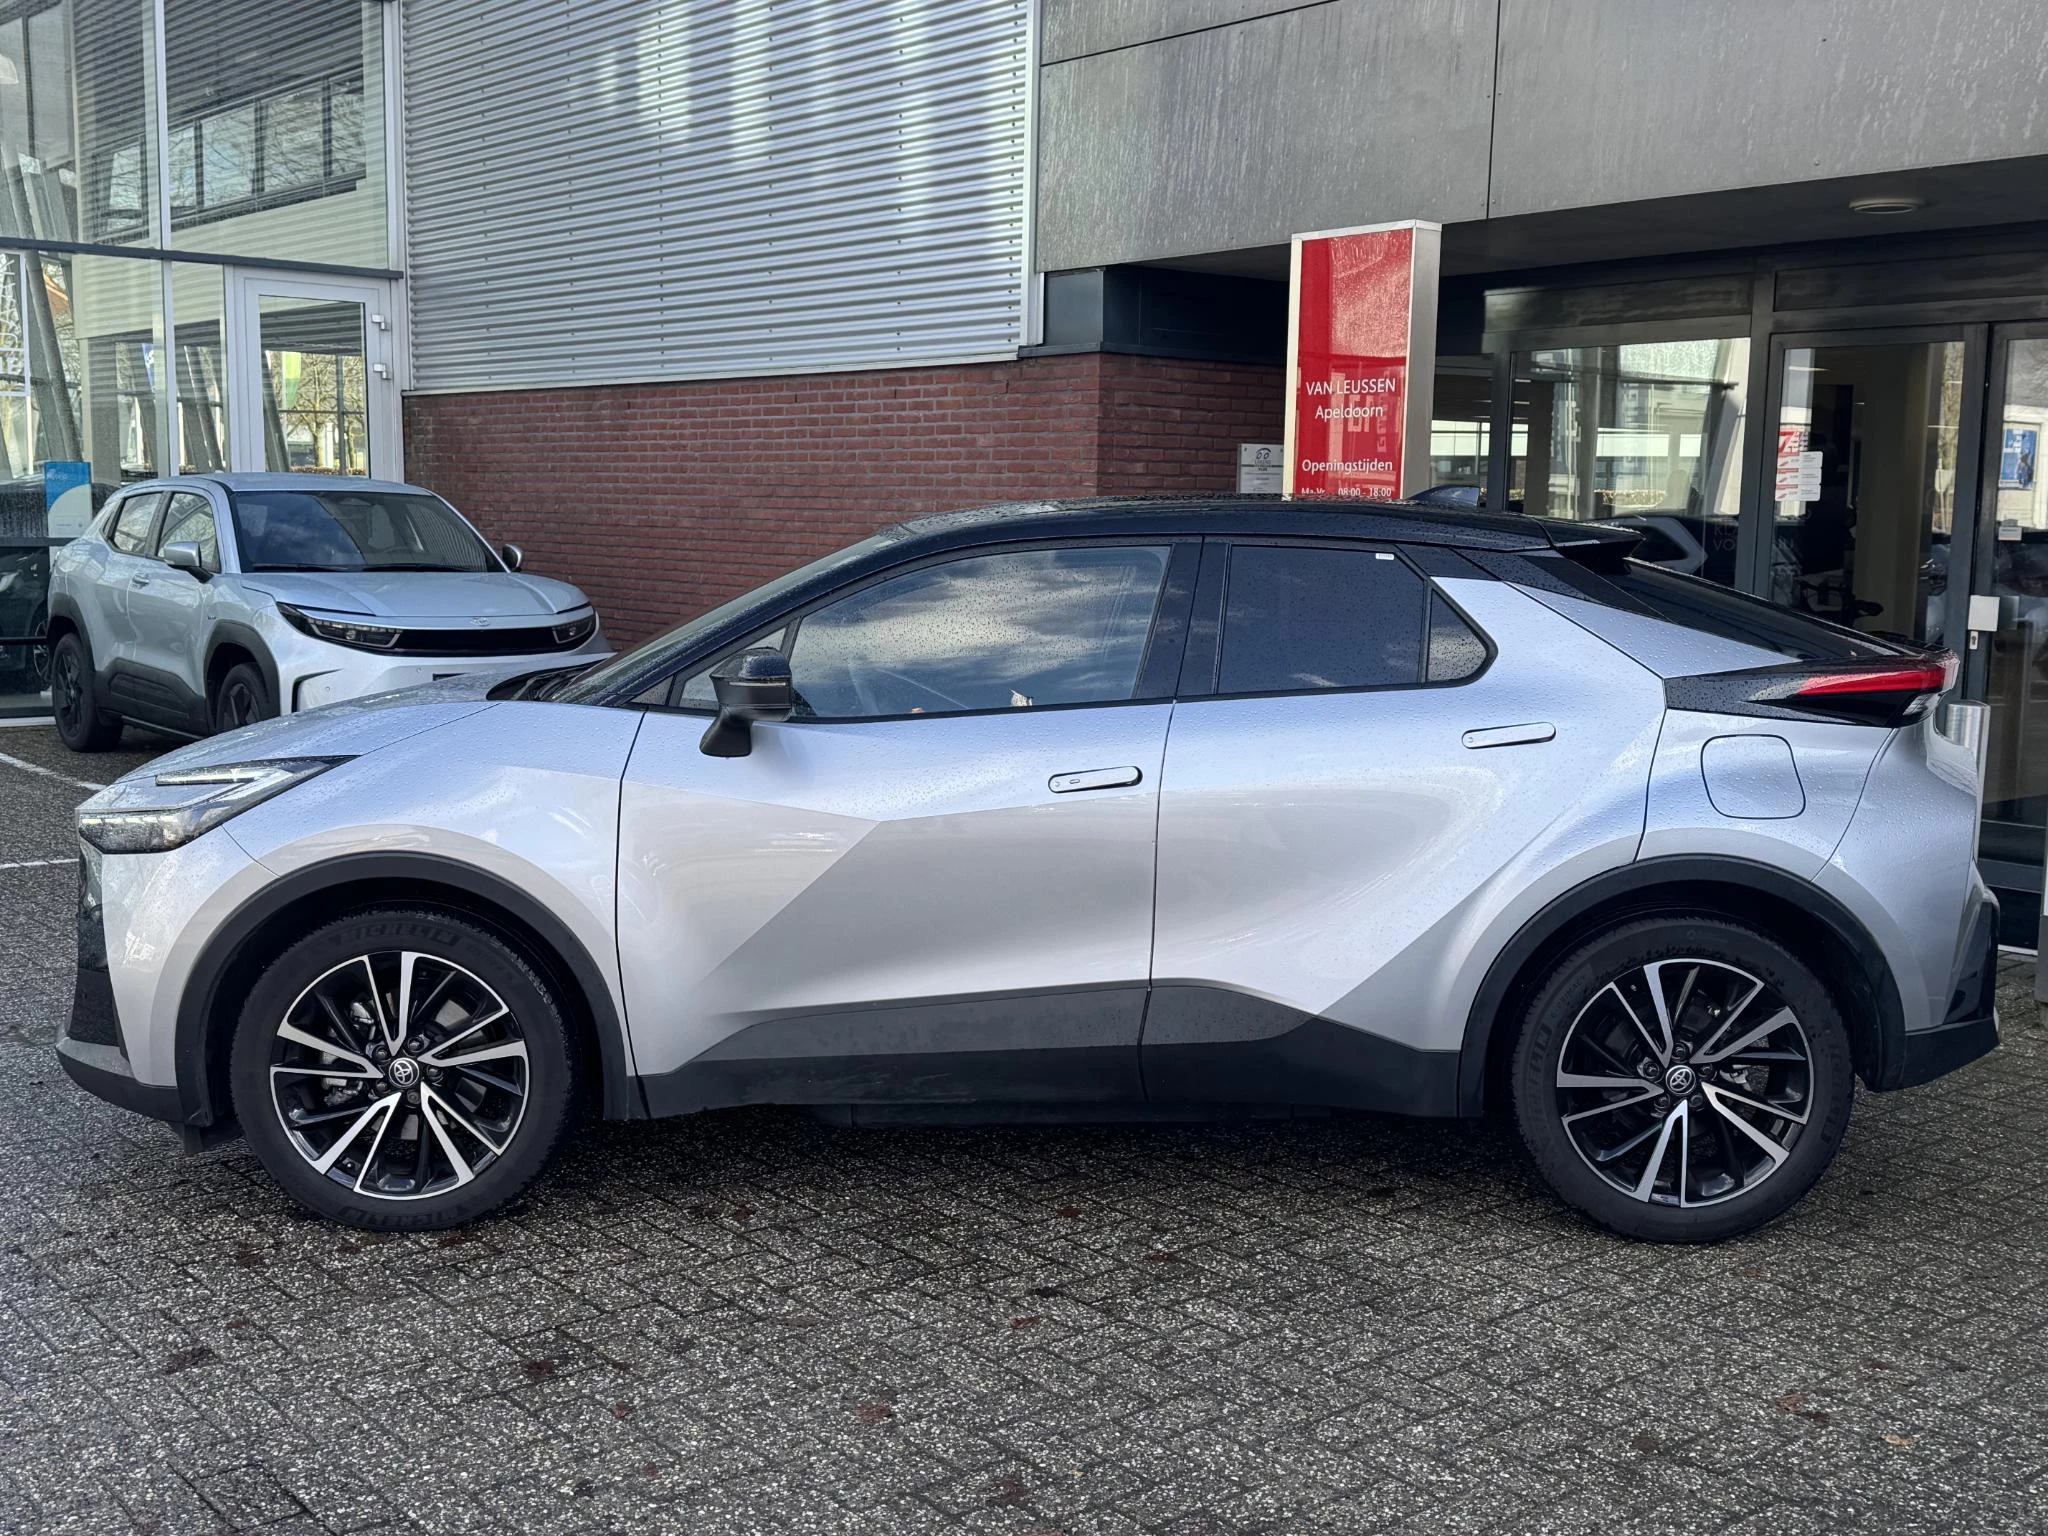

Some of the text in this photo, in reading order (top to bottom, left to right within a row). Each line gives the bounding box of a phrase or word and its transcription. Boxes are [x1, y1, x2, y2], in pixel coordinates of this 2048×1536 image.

[1305, 378, 1396, 395] VAN LEUSSEN
[1315, 404, 1384, 422] Apeldoorn
[1302, 458, 1393, 475] Openingstijden
[1338, 487, 1361, 496] 08:00
[1369, 487, 1392, 497] 18:00
